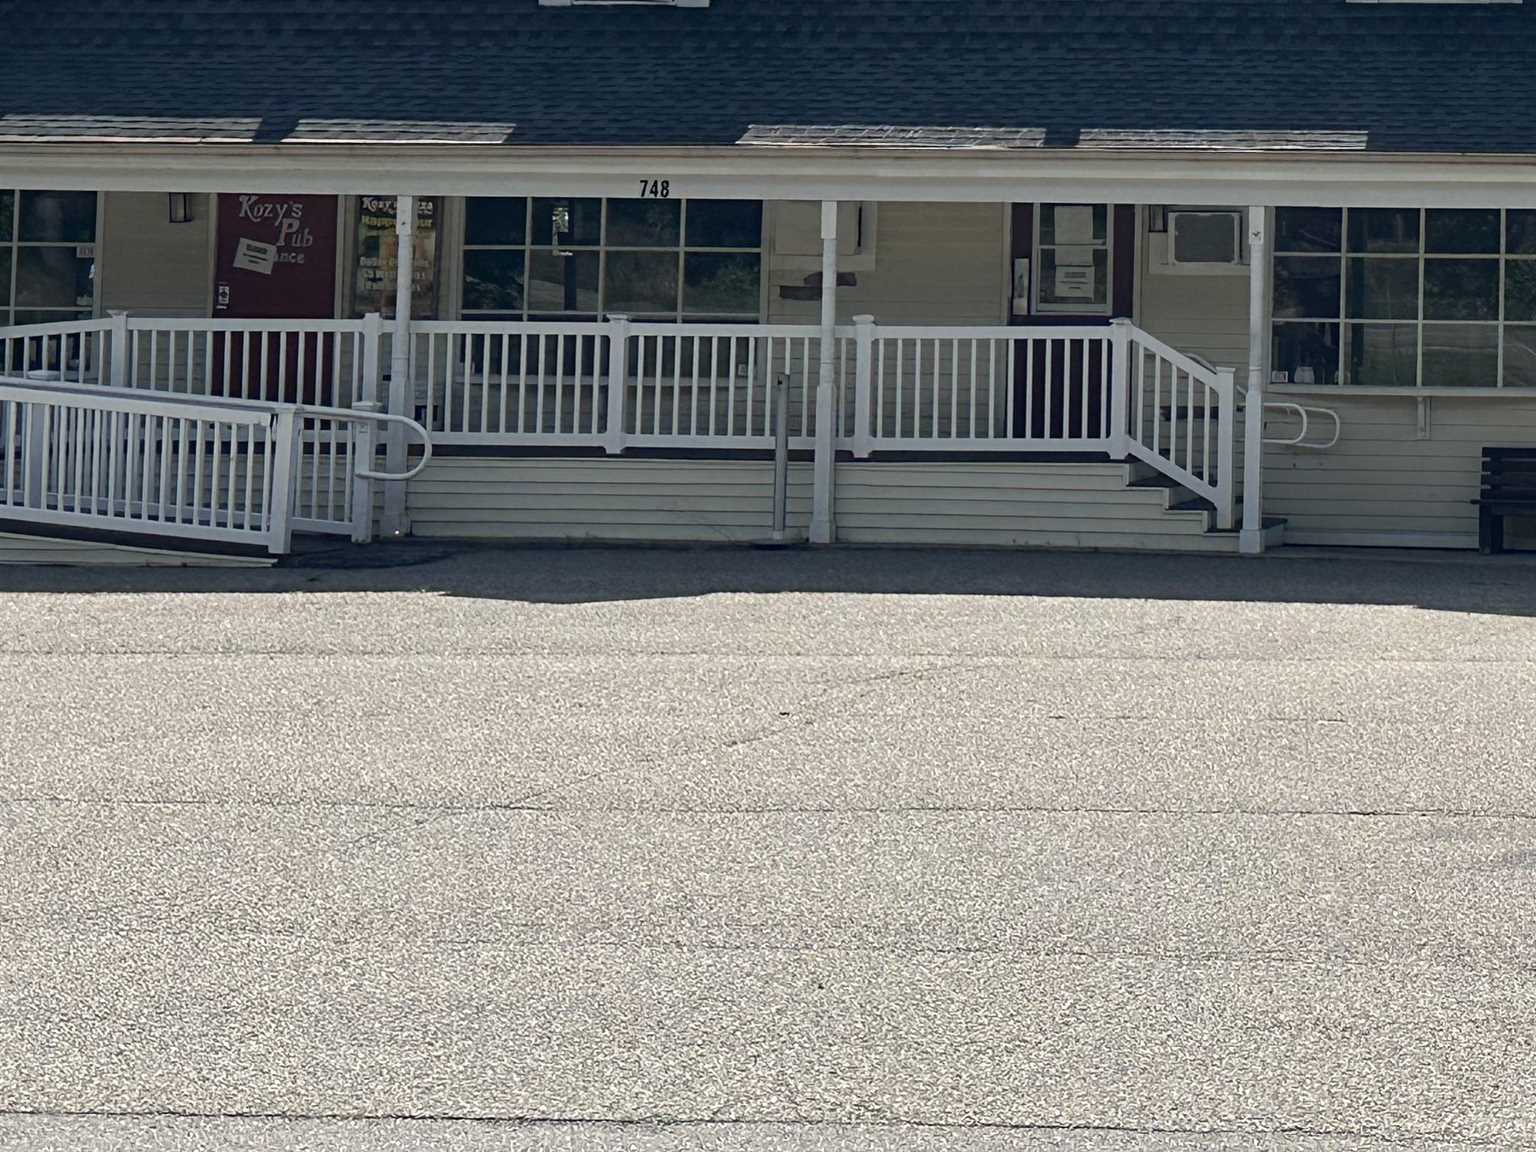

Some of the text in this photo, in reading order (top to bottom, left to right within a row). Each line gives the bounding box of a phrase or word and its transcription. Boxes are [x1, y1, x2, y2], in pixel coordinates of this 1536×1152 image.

[640, 179, 670, 198] 748
[238, 195, 303, 226] Kozy's
[276, 218, 313, 247] Pub
